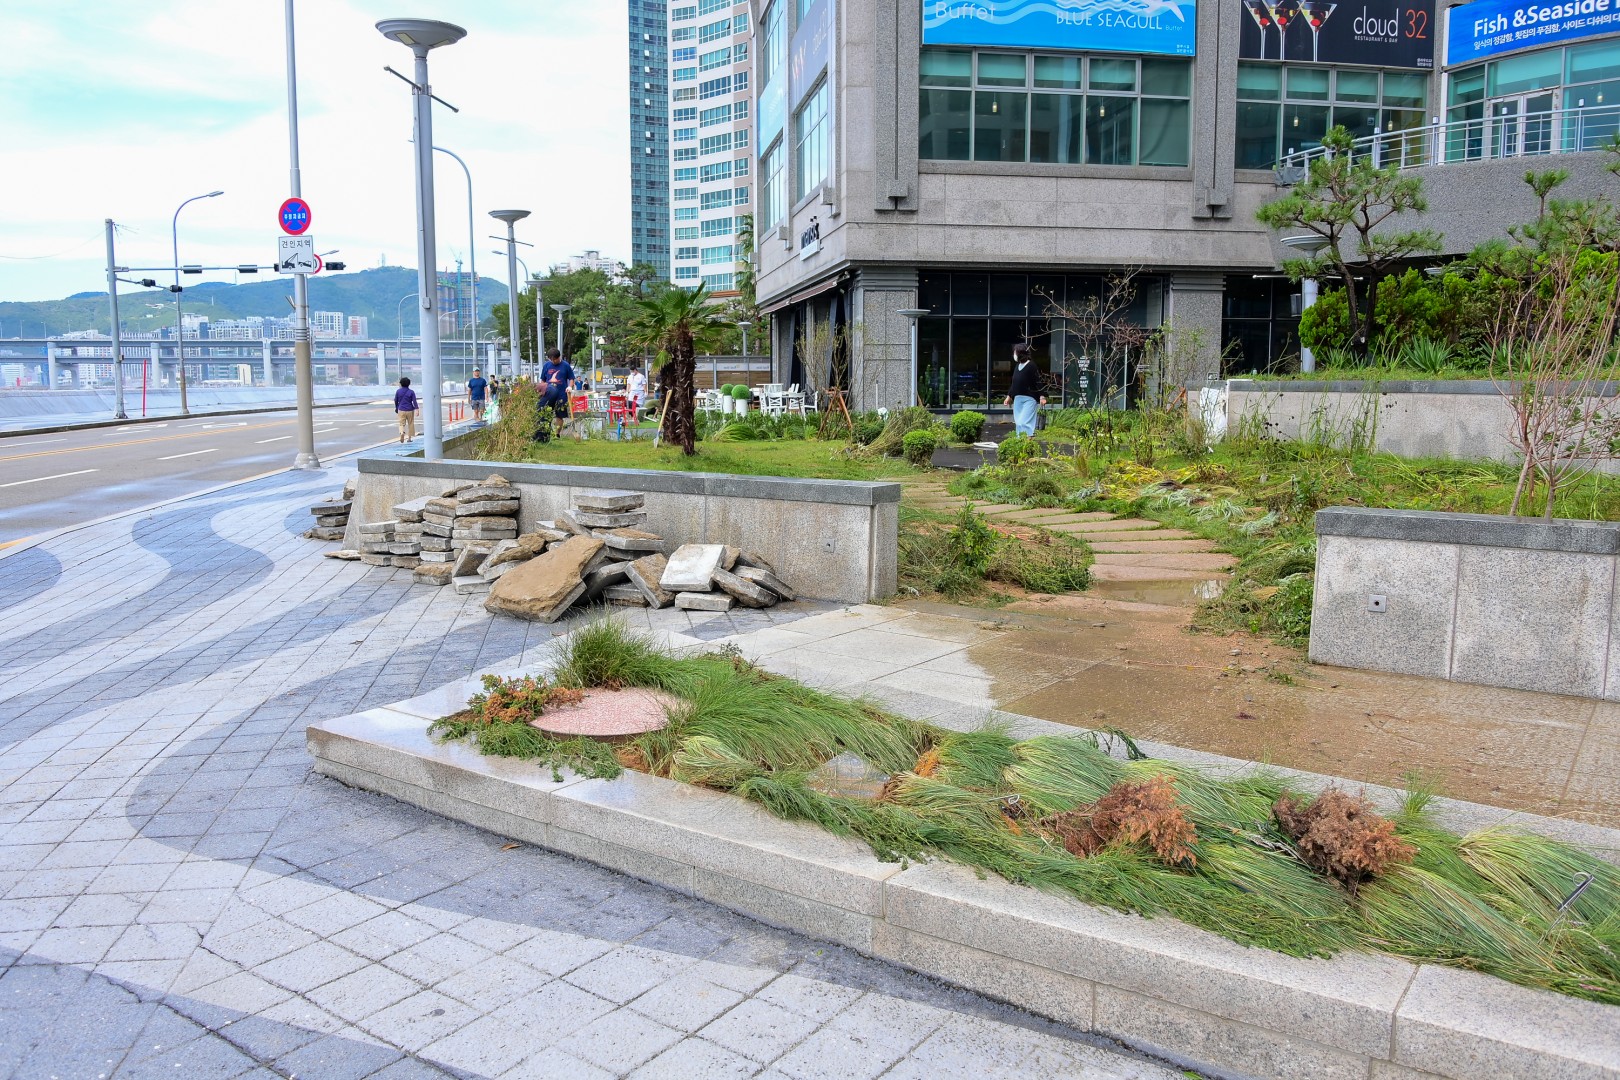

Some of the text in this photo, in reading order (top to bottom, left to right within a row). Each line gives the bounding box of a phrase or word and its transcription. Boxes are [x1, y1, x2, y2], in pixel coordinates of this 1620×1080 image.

[934, 1, 997, 20] Buffet
[1056, 10, 1093, 26] BLUE
[1097, 12, 1163, 30] SEAGULL
[1353, 5, 1427, 39] cloud 32
[1473, 37, 1493, 51] 일식의
[1493, 32, 1514, 46] 정갈함,
[1514, 27, 1536, 42] 횟집의
[1536, 22, 1561, 36] 푸짐함,
[1561, 19, 1586, 31] 사이드
[1586, 13, 1612, 26] 디쉬의
[1474, 13, 1508, 38] Fish
[282, 240, 311, 248] 견인지역
